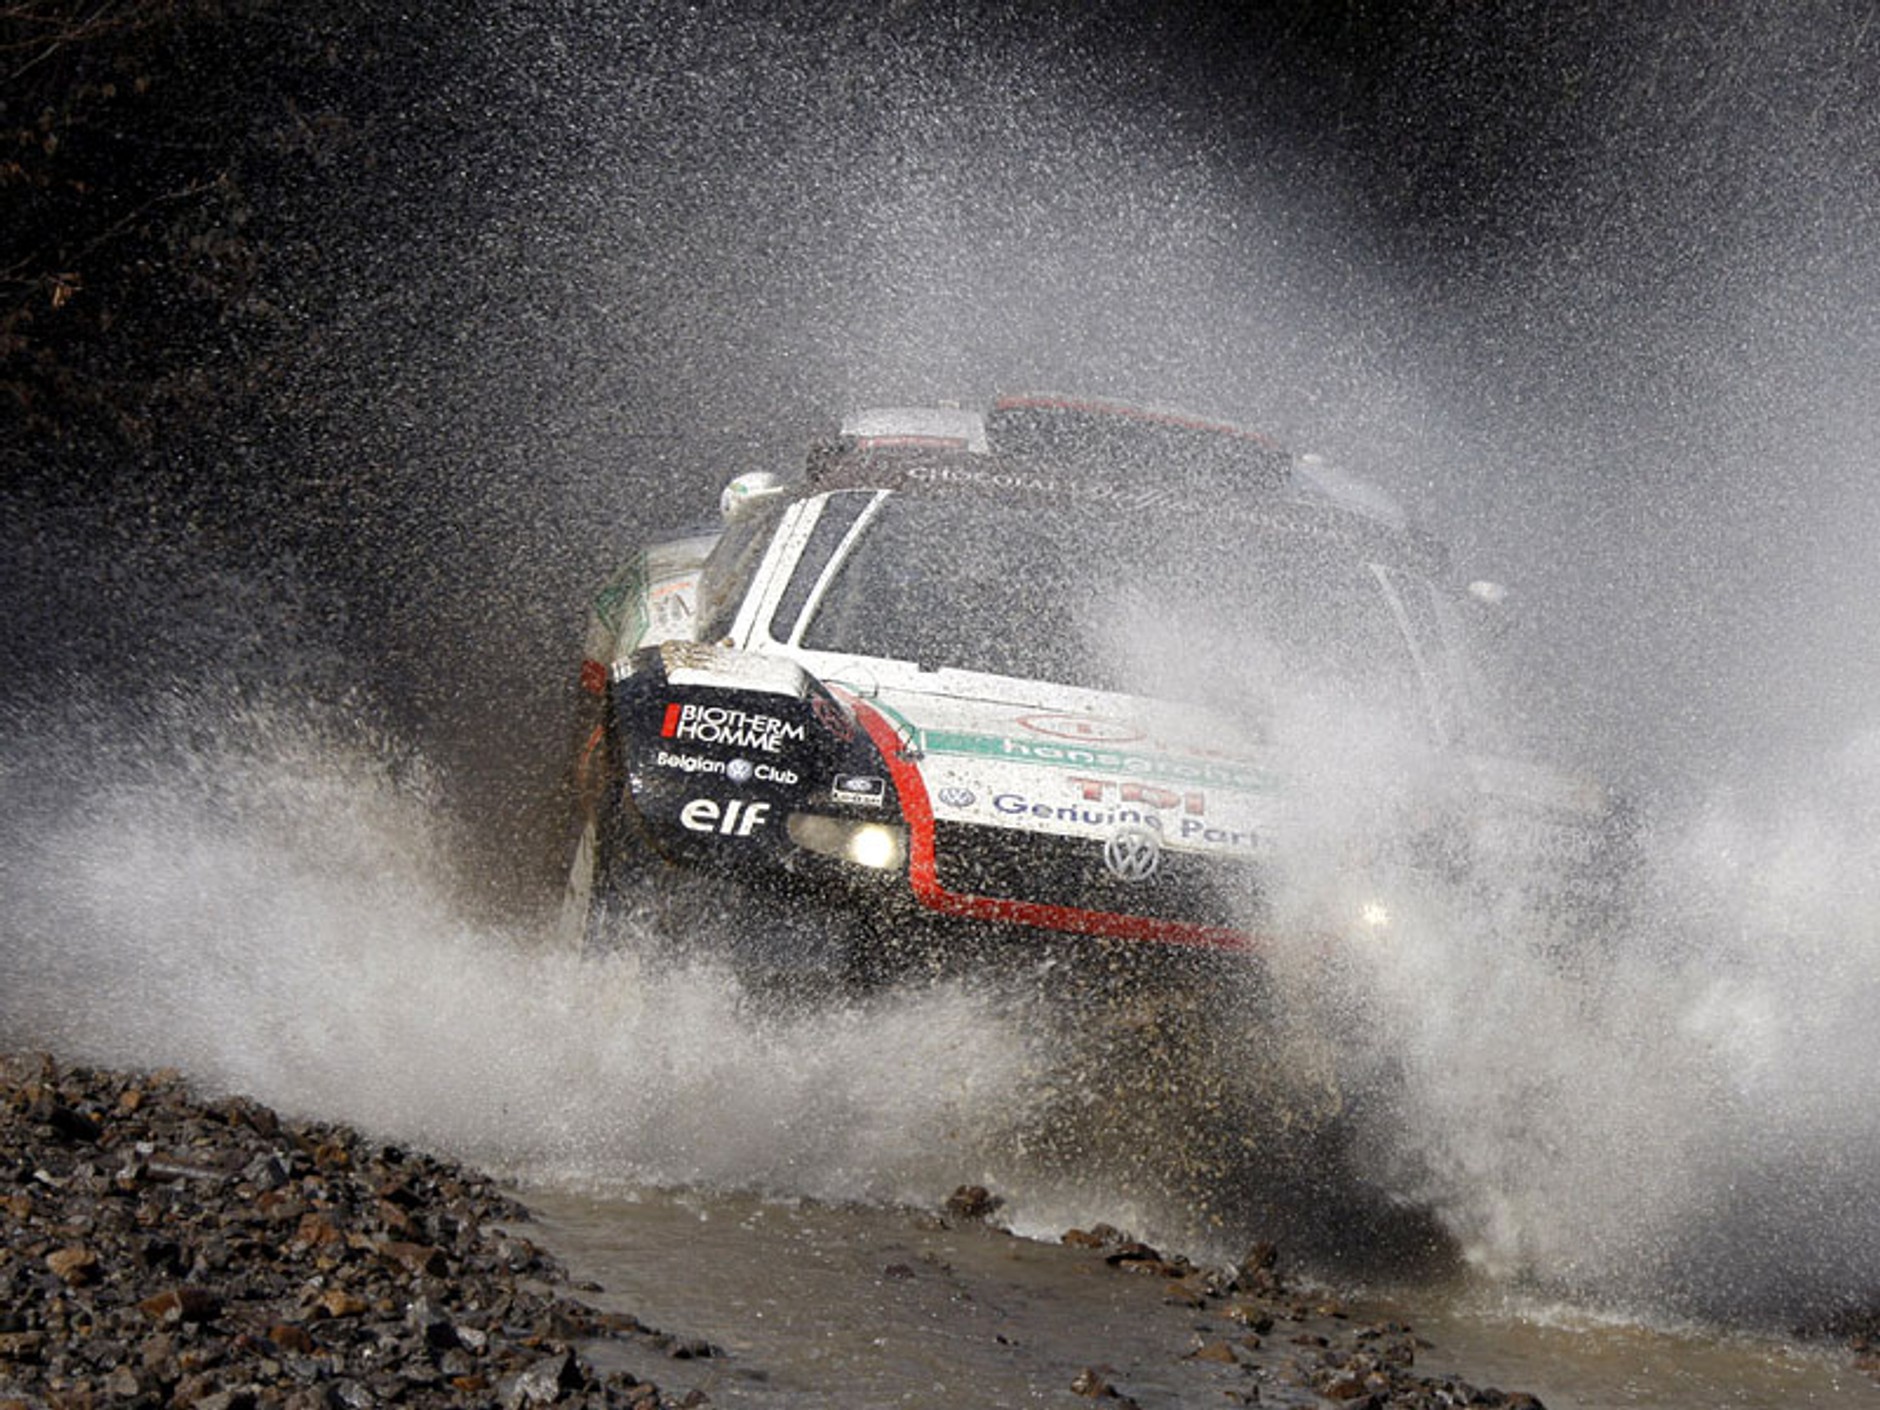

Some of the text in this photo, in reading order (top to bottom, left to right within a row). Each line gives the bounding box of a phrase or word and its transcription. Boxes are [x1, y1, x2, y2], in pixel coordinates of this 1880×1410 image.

[676, 721, 783, 753] HOMME
[682, 704, 805, 741] BIOTHERM
[657, 751, 726, 773] Belgian
[753, 764, 799, 785] Club
[993, 793, 1162, 832] Genuine
[1068, 776, 1204, 816] TDI
[680, 799, 770, 836] elf
